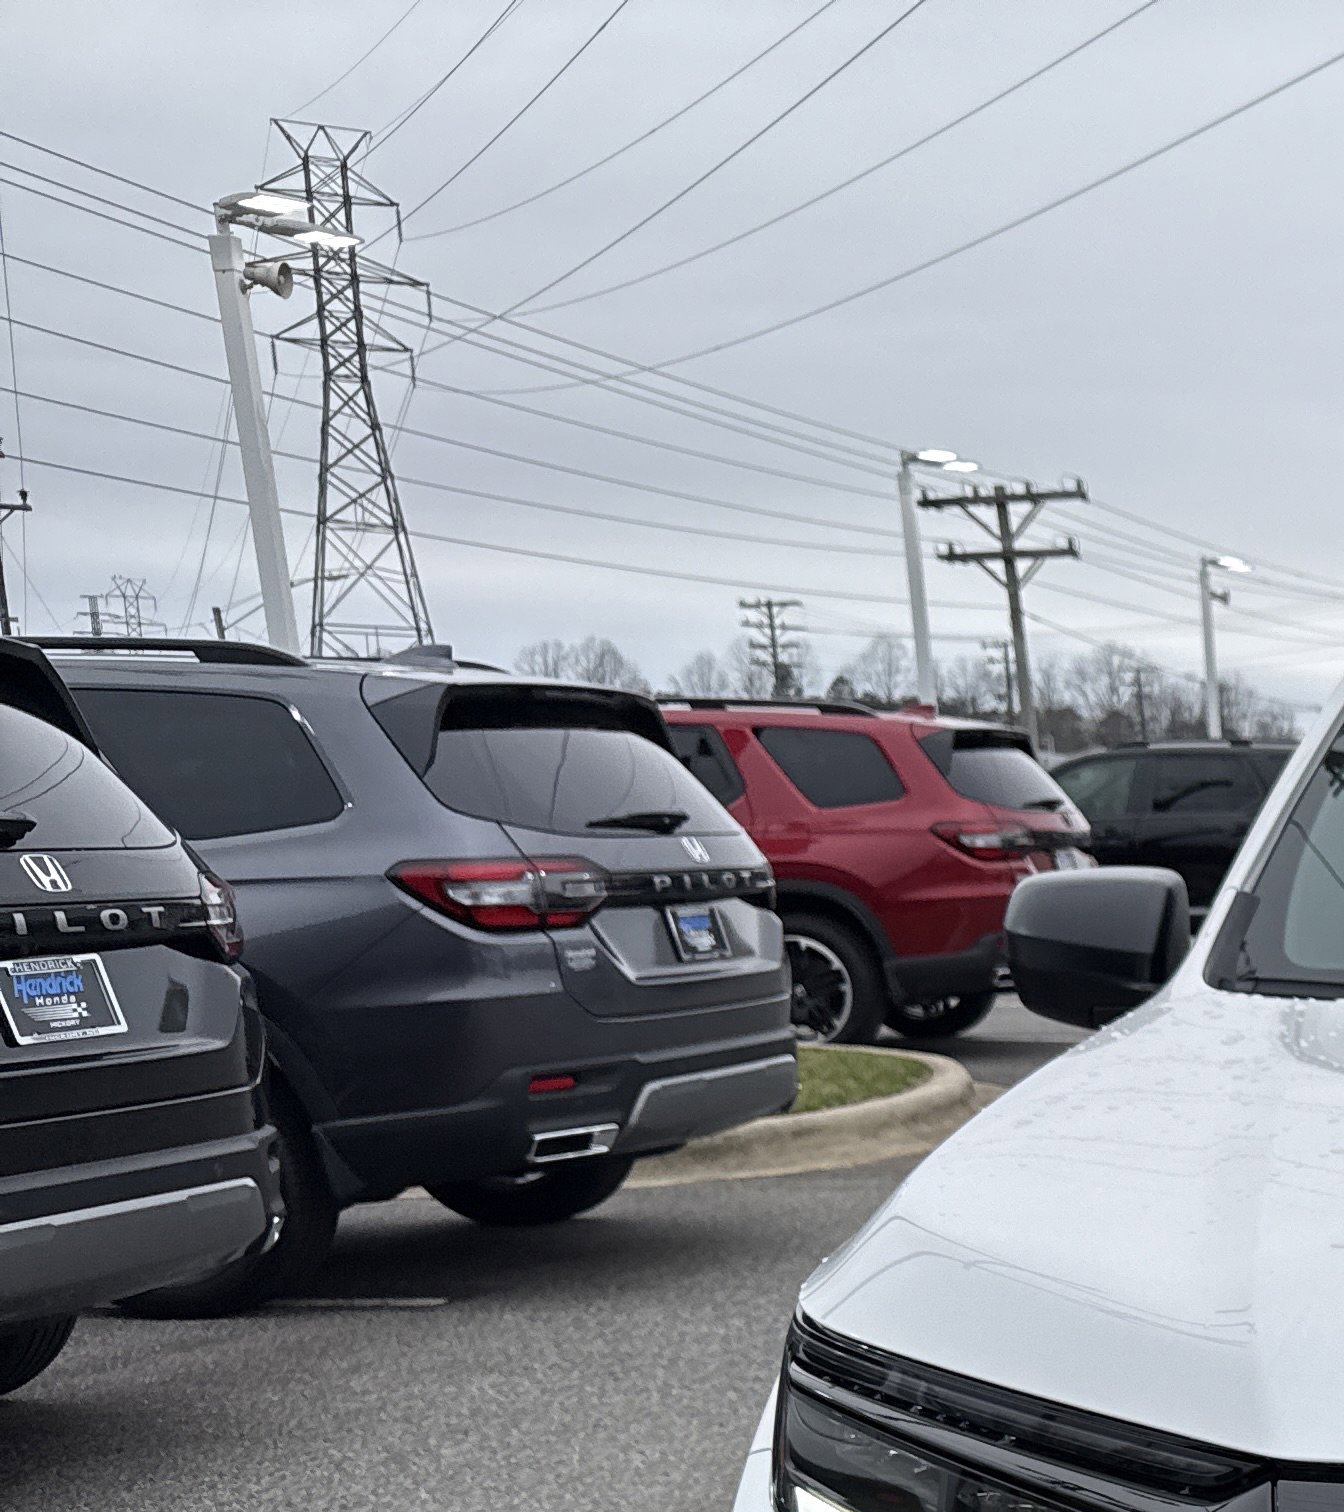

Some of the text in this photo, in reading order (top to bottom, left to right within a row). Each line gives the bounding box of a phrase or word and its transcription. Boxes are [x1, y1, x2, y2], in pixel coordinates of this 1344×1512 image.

[653, 870, 752, 893] PILOT
[14, 959, 76, 973] HENDRICK
[13, 970, 84, 1004] Hendrick
[35, 994, 77, 1007] Honda
